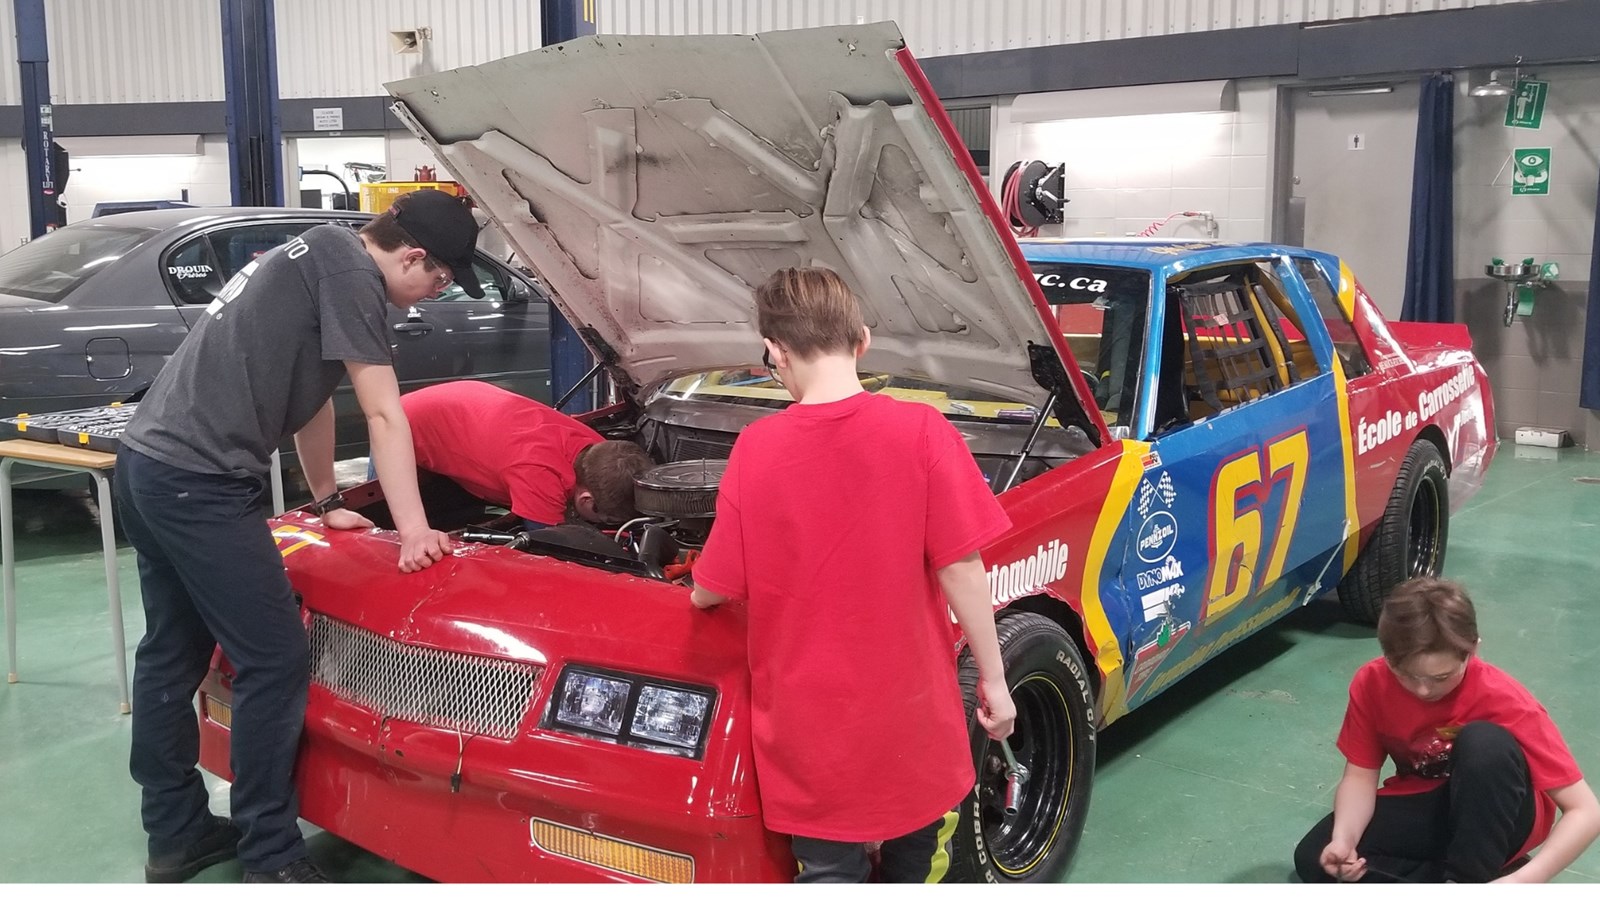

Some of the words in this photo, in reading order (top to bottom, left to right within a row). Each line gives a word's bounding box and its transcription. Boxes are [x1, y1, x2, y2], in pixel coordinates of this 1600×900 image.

[43, 131, 51, 181] ROTARY
[168, 264, 213, 275] DROUIN
[1357, 409, 1402, 456] École
[1405, 410, 1418, 431] de
[1140, 525, 1175, 551] PENNZOIL
[1201, 425, 1311, 622] 67
[1055, 649, 1090, 704] RADIAL
[973, 783, 987, 865] COBRA
